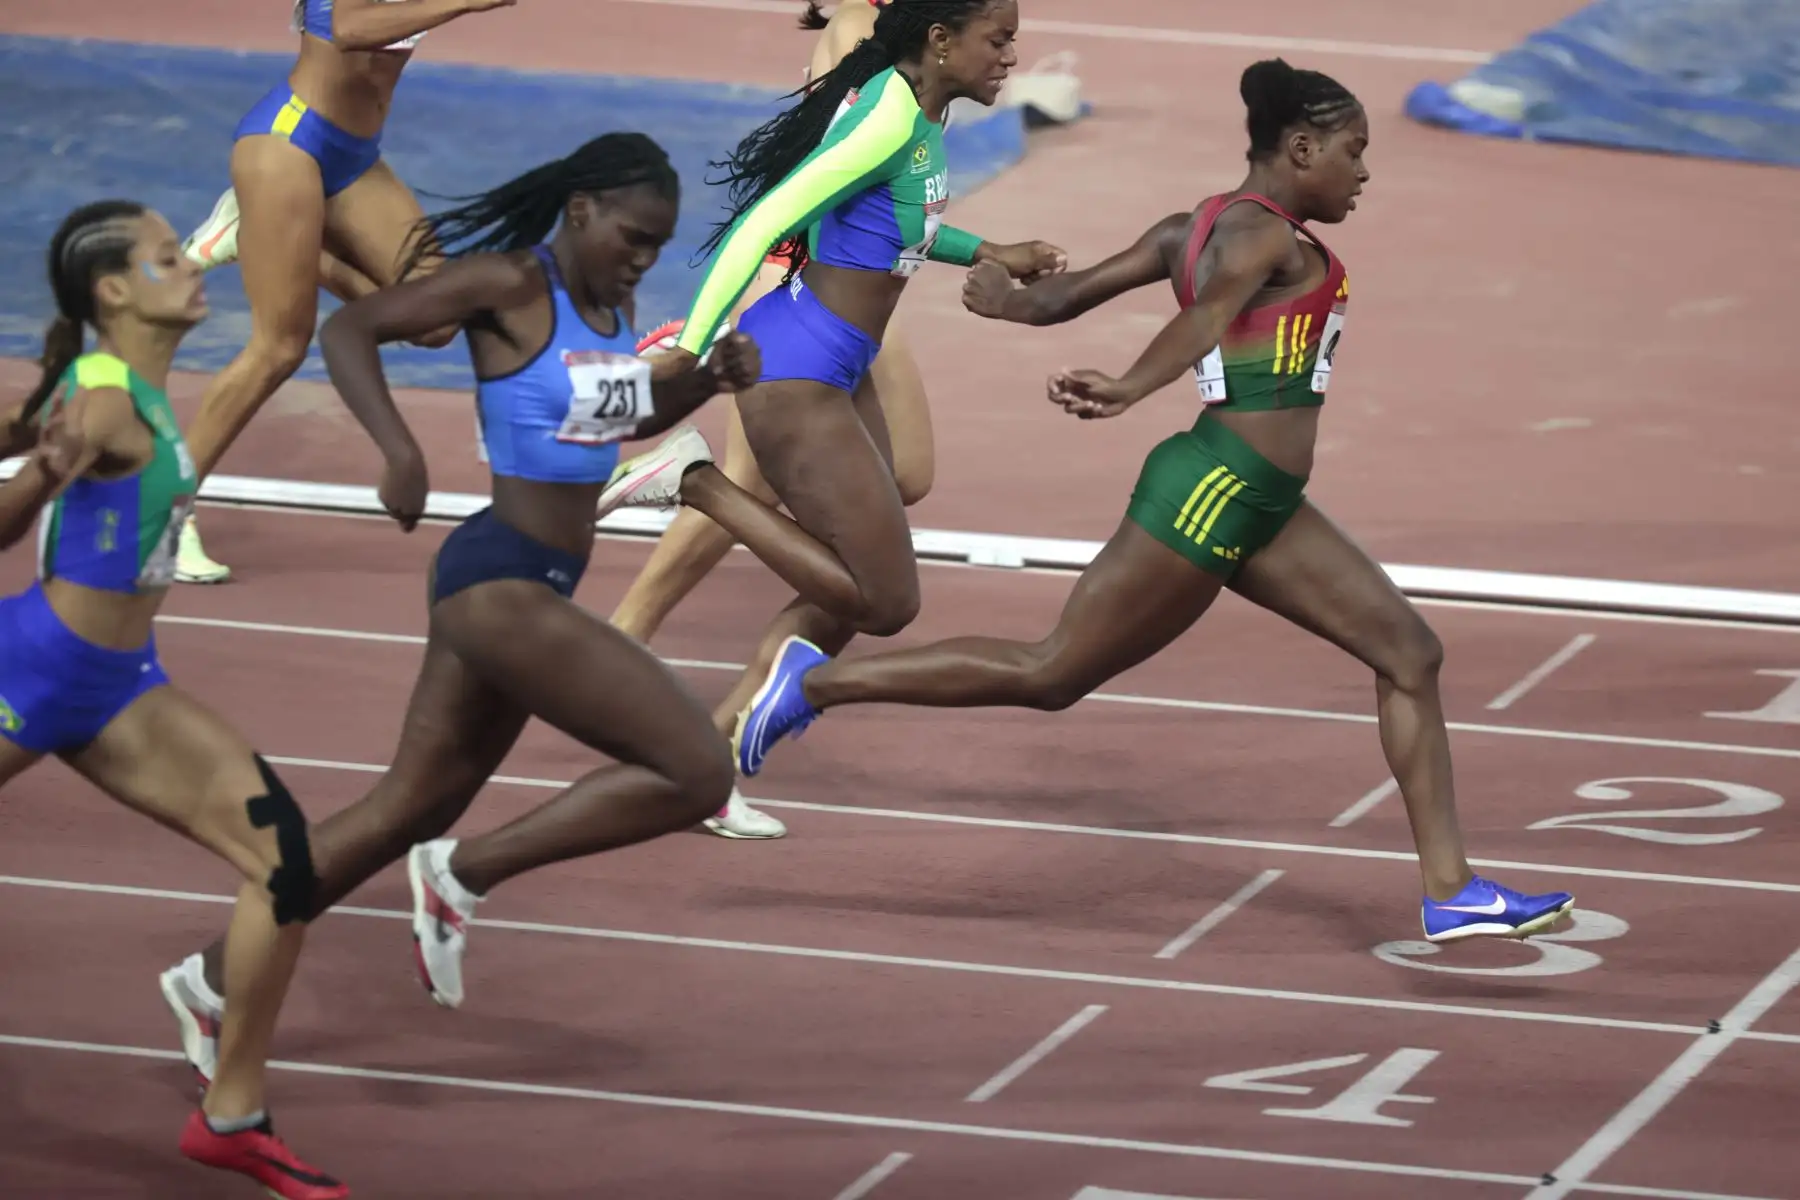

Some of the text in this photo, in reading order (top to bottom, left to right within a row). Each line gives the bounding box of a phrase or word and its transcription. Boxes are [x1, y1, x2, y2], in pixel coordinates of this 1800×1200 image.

[592, 378, 637, 419] 231
[1525, 777, 1785, 845] 2
[1372, 908, 1630, 977] 3
[1201, 1047, 1440, 1127] 4
